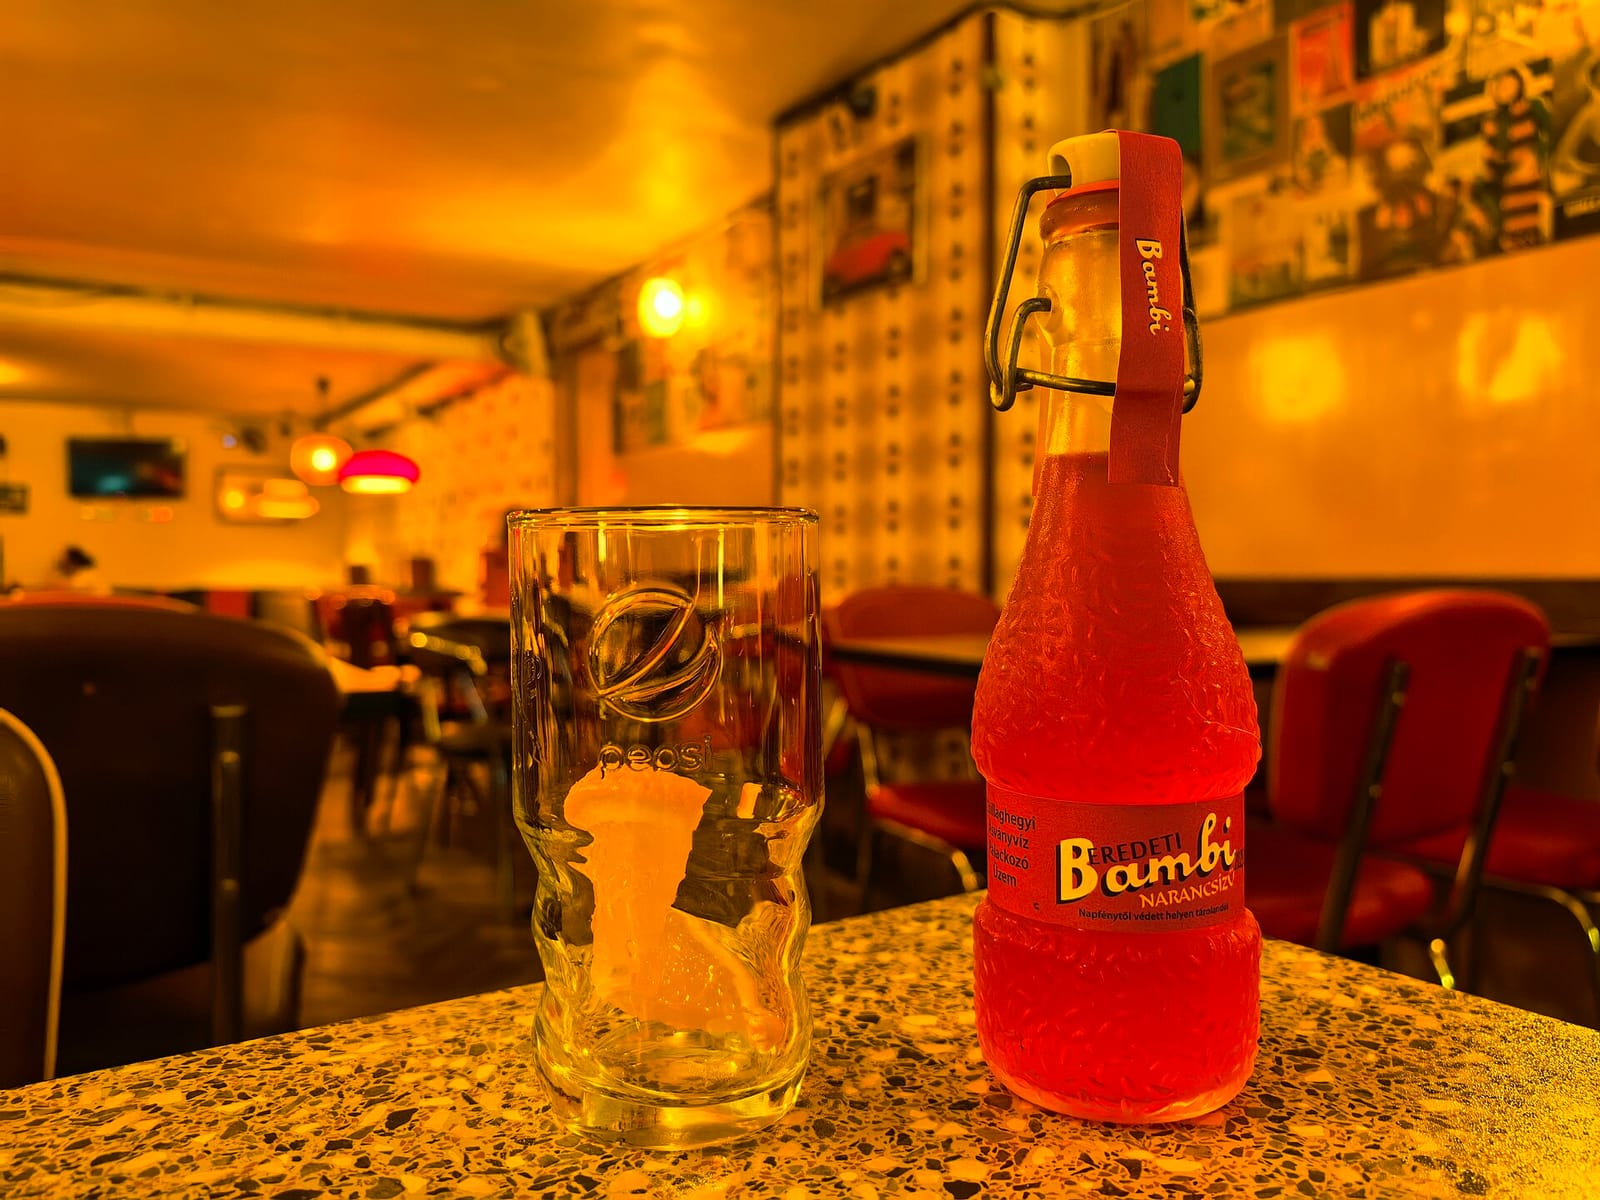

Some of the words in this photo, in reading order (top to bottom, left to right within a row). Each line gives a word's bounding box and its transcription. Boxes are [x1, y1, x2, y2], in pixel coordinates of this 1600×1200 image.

[1135, 238, 1172, 335] Bambi
[1057, 812, 1236, 904] Bambi
[1088, 832, 1182, 866] EREDETI
[1078, 908, 1132, 922] Napfénytől
[1134, 910, 1165, 920] védett
[1165, 907, 1194, 920] helyen
